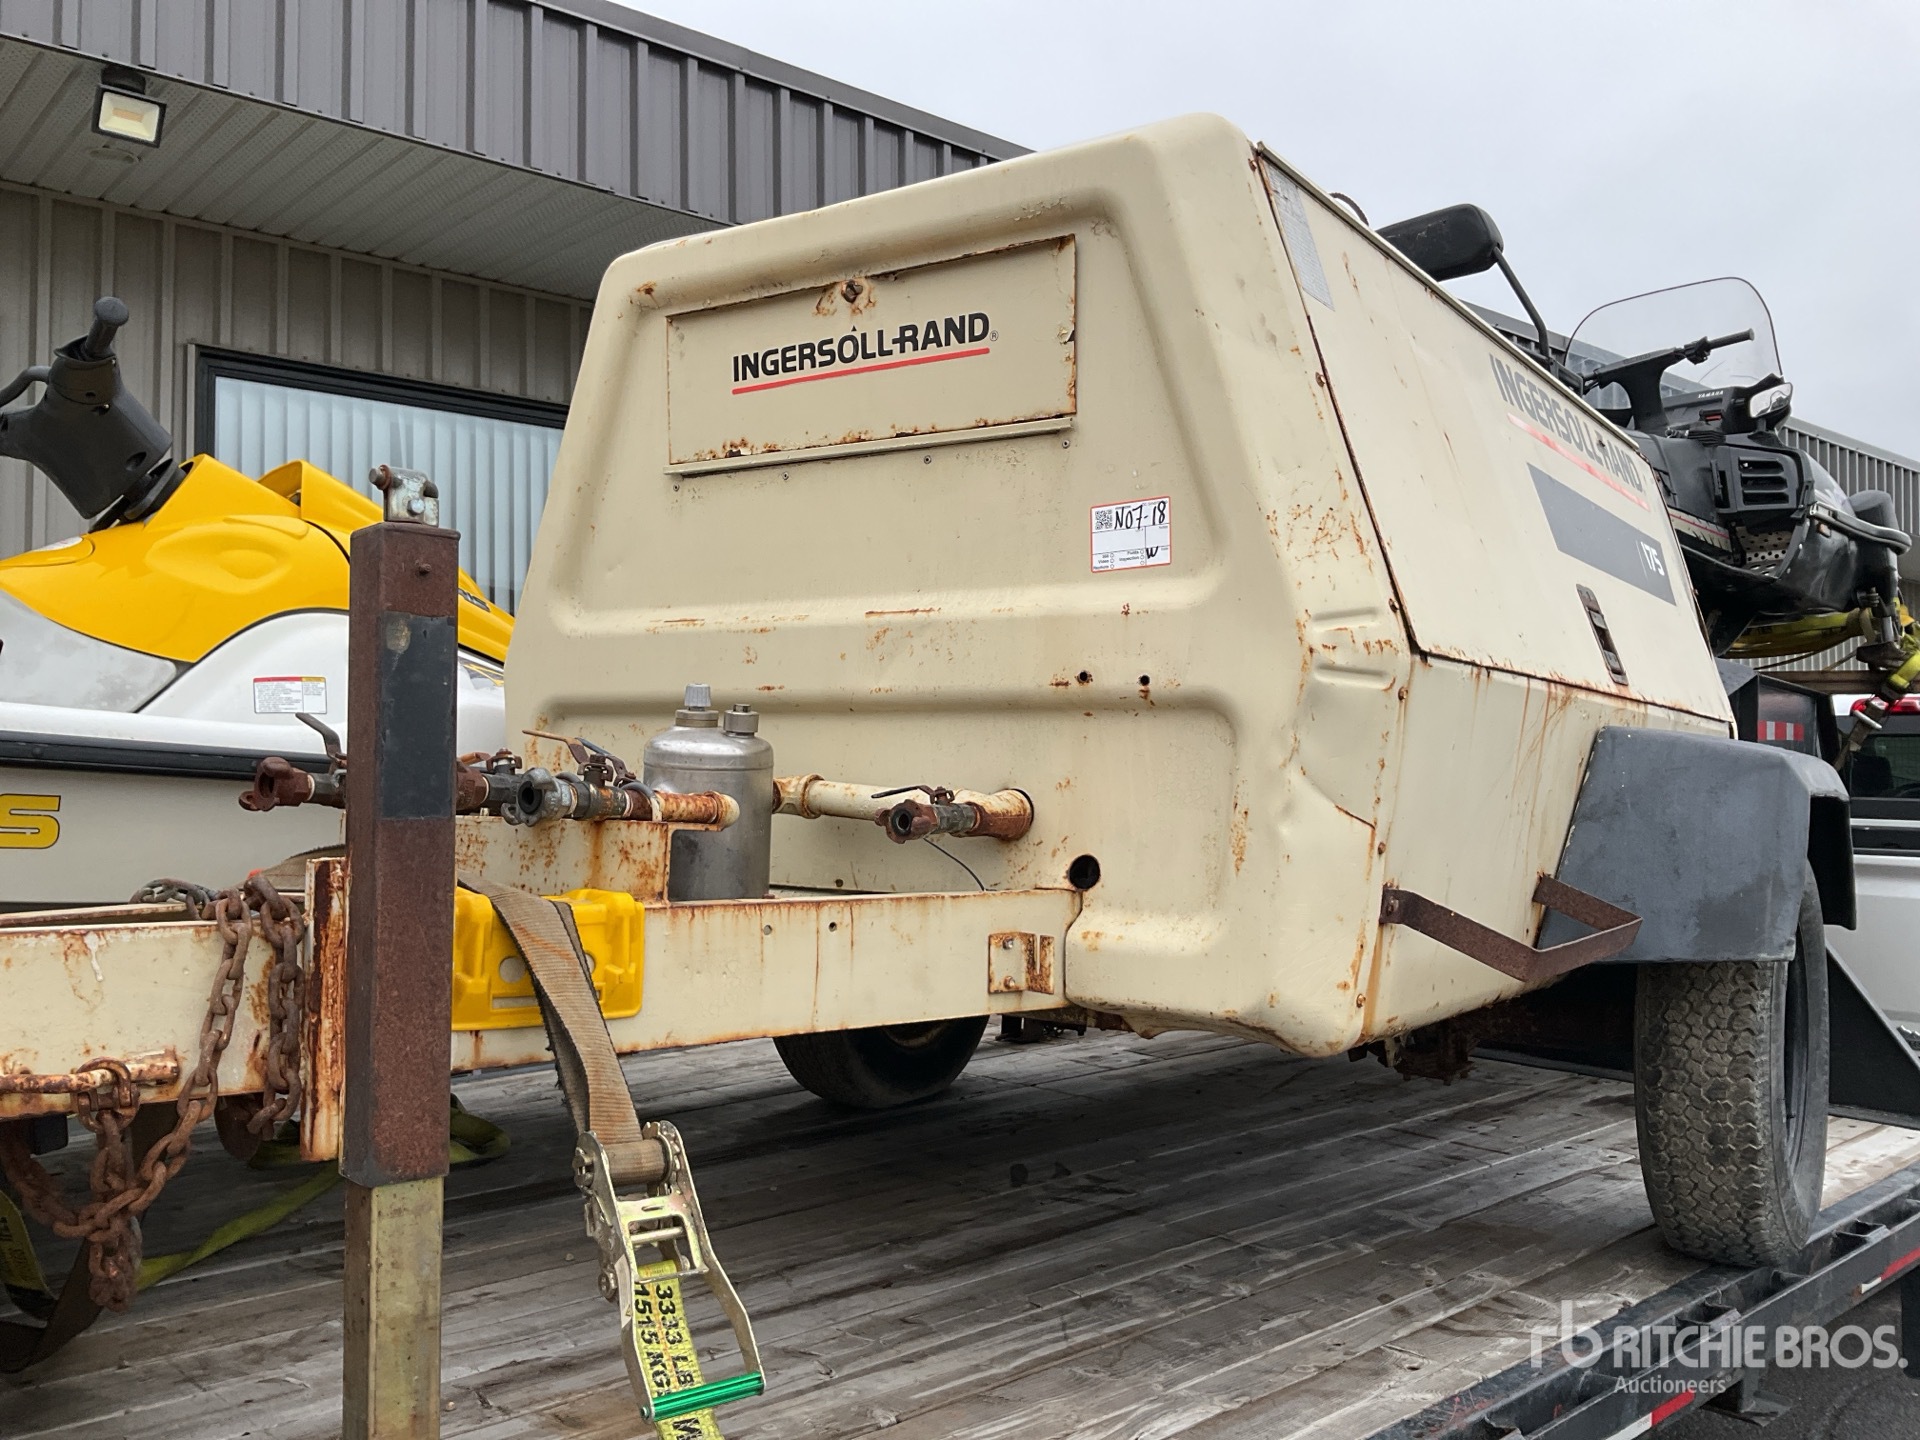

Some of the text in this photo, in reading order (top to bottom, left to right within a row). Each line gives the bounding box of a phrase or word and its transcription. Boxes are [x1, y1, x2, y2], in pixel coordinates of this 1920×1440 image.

[733, 312, 990, 382] INGERSOLL-RAND
[634, 1282, 661, 1346] 1515
[655, 1284, 695, 1387] 3333 LB
